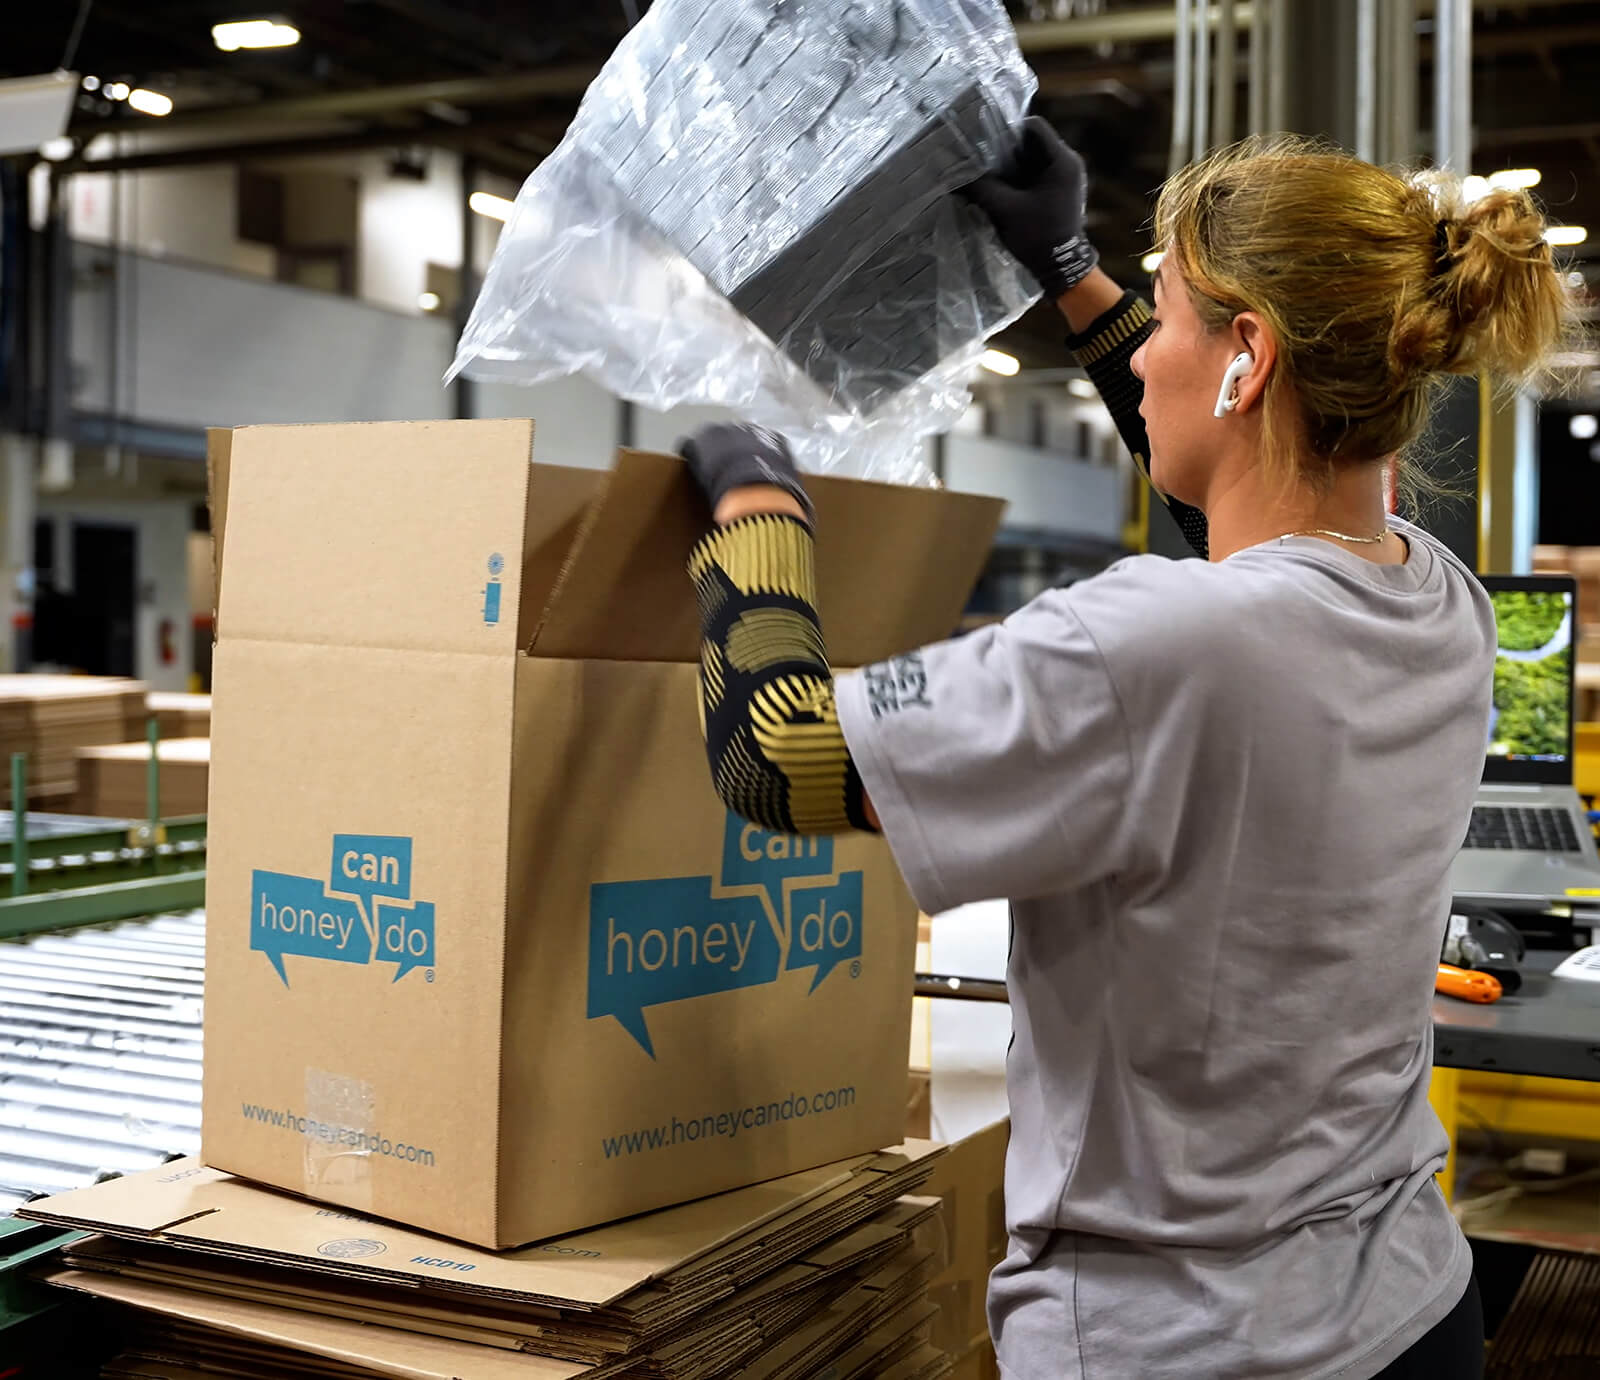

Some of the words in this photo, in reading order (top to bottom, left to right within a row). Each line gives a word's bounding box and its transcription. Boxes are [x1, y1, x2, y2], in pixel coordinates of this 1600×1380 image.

[342, 849, 399, 885] can
[739, 826, 818, 862] can
[261, 893, 354, 949] honey
[385, 917, 428, 957] do
[606, 917, 756, 975] honey
[799, 898, 853, 953] do
[241, 1101, 435, 1167] www.honeycando.com
[602, 1085, 856, 1159] www.honeycando.com
[410, 1255, 477, 1272] HCD10
